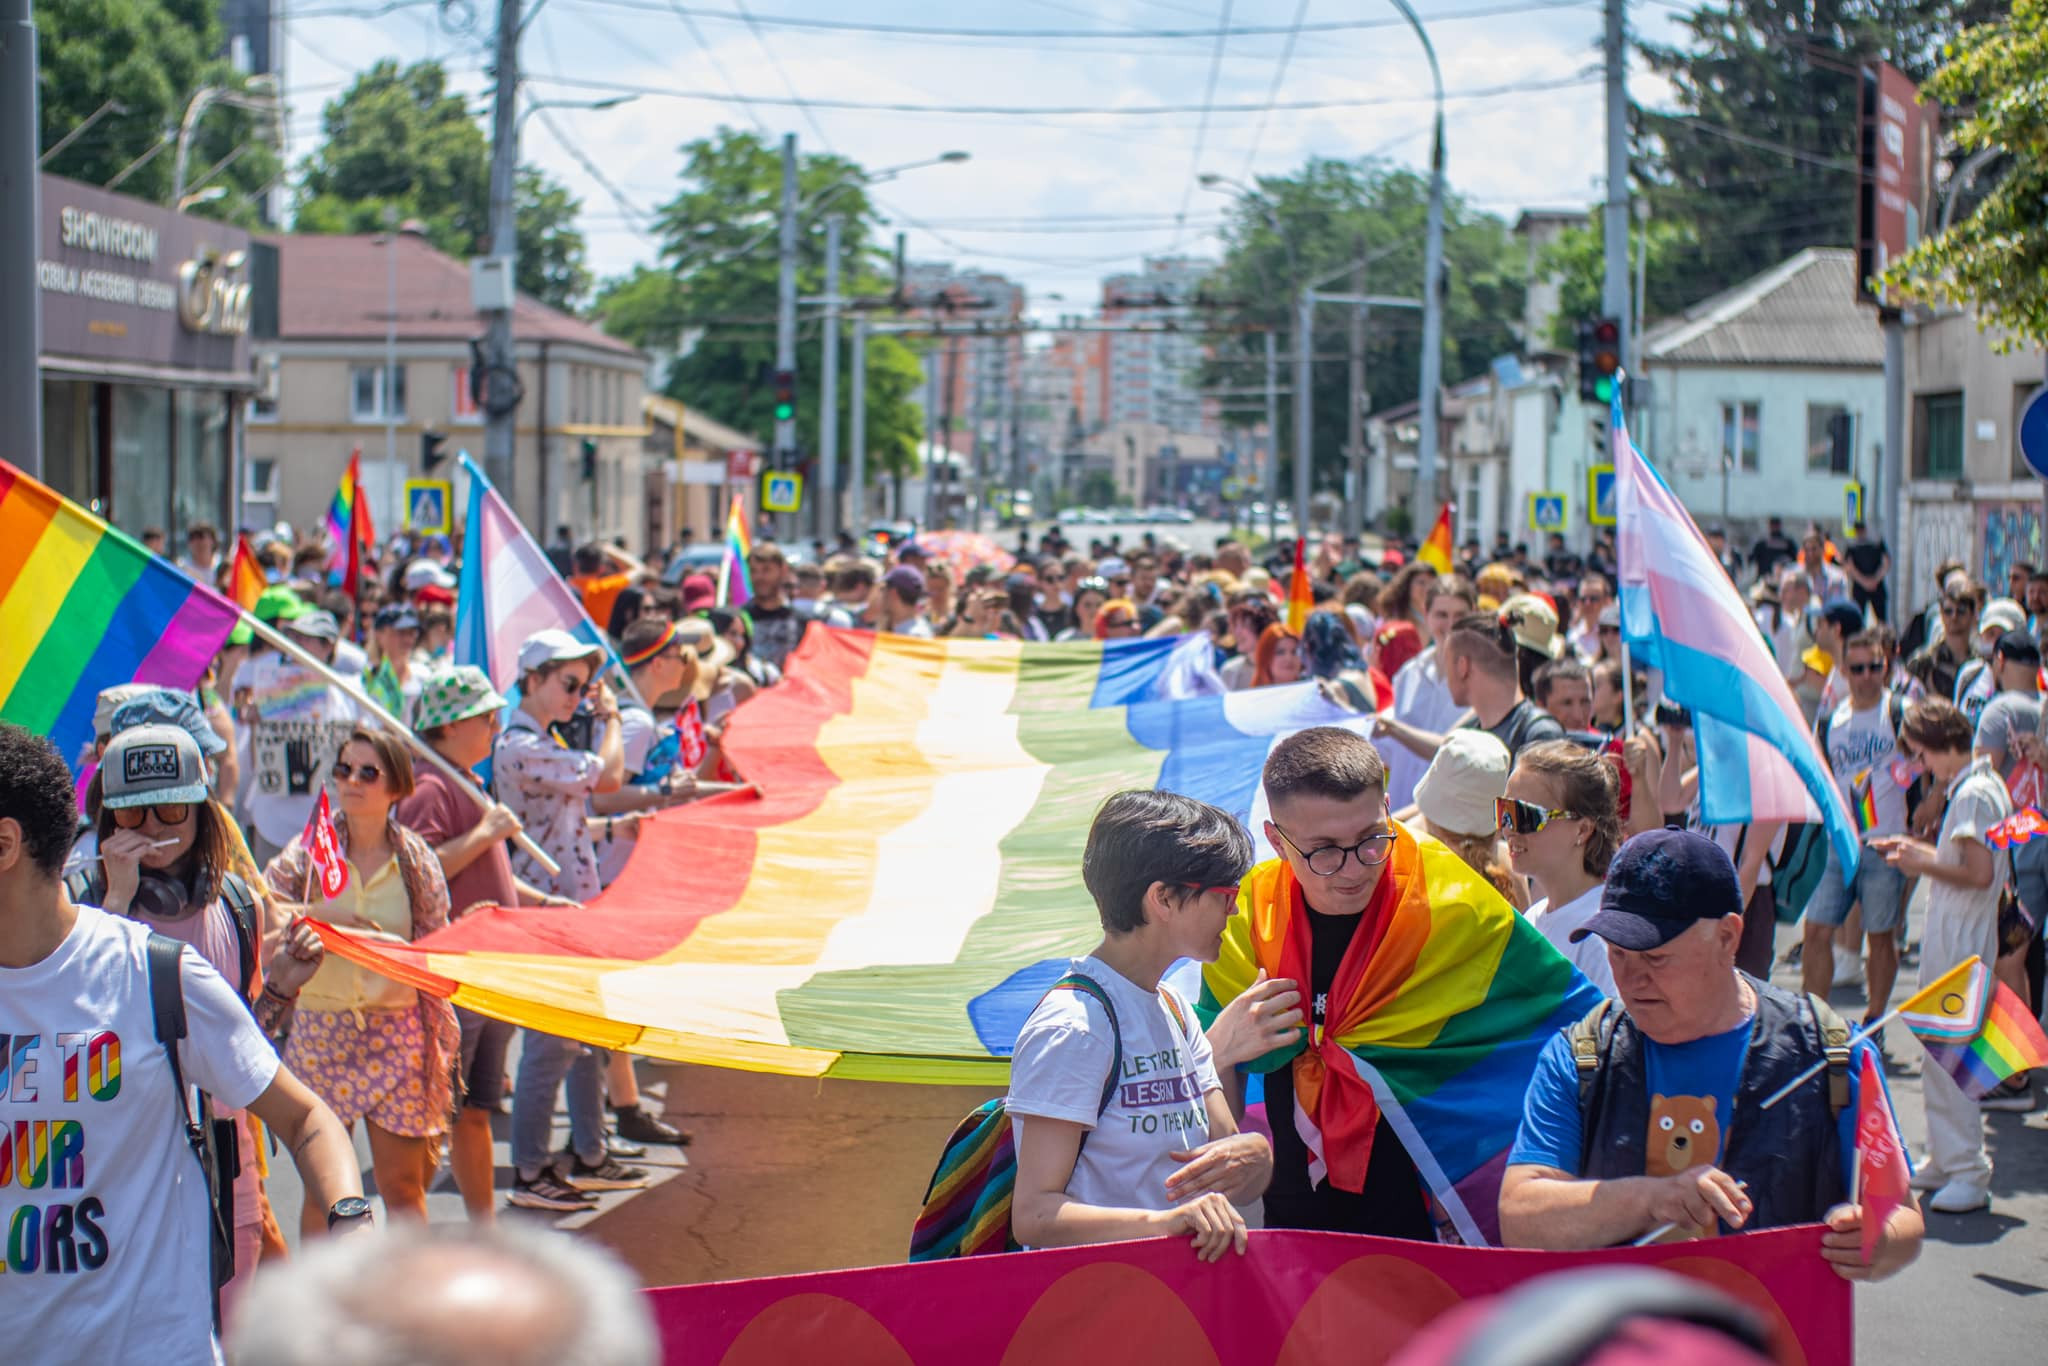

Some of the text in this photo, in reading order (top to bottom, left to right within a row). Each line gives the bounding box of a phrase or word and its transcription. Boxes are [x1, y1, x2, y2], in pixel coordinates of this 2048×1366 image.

[62, 206, 158, 262] SHOWROOM
[56, 1030, 122, 1102] TO
[1128, 1114, 1158, 1134] TO
[0, 1196, 110, 1274] ORS
